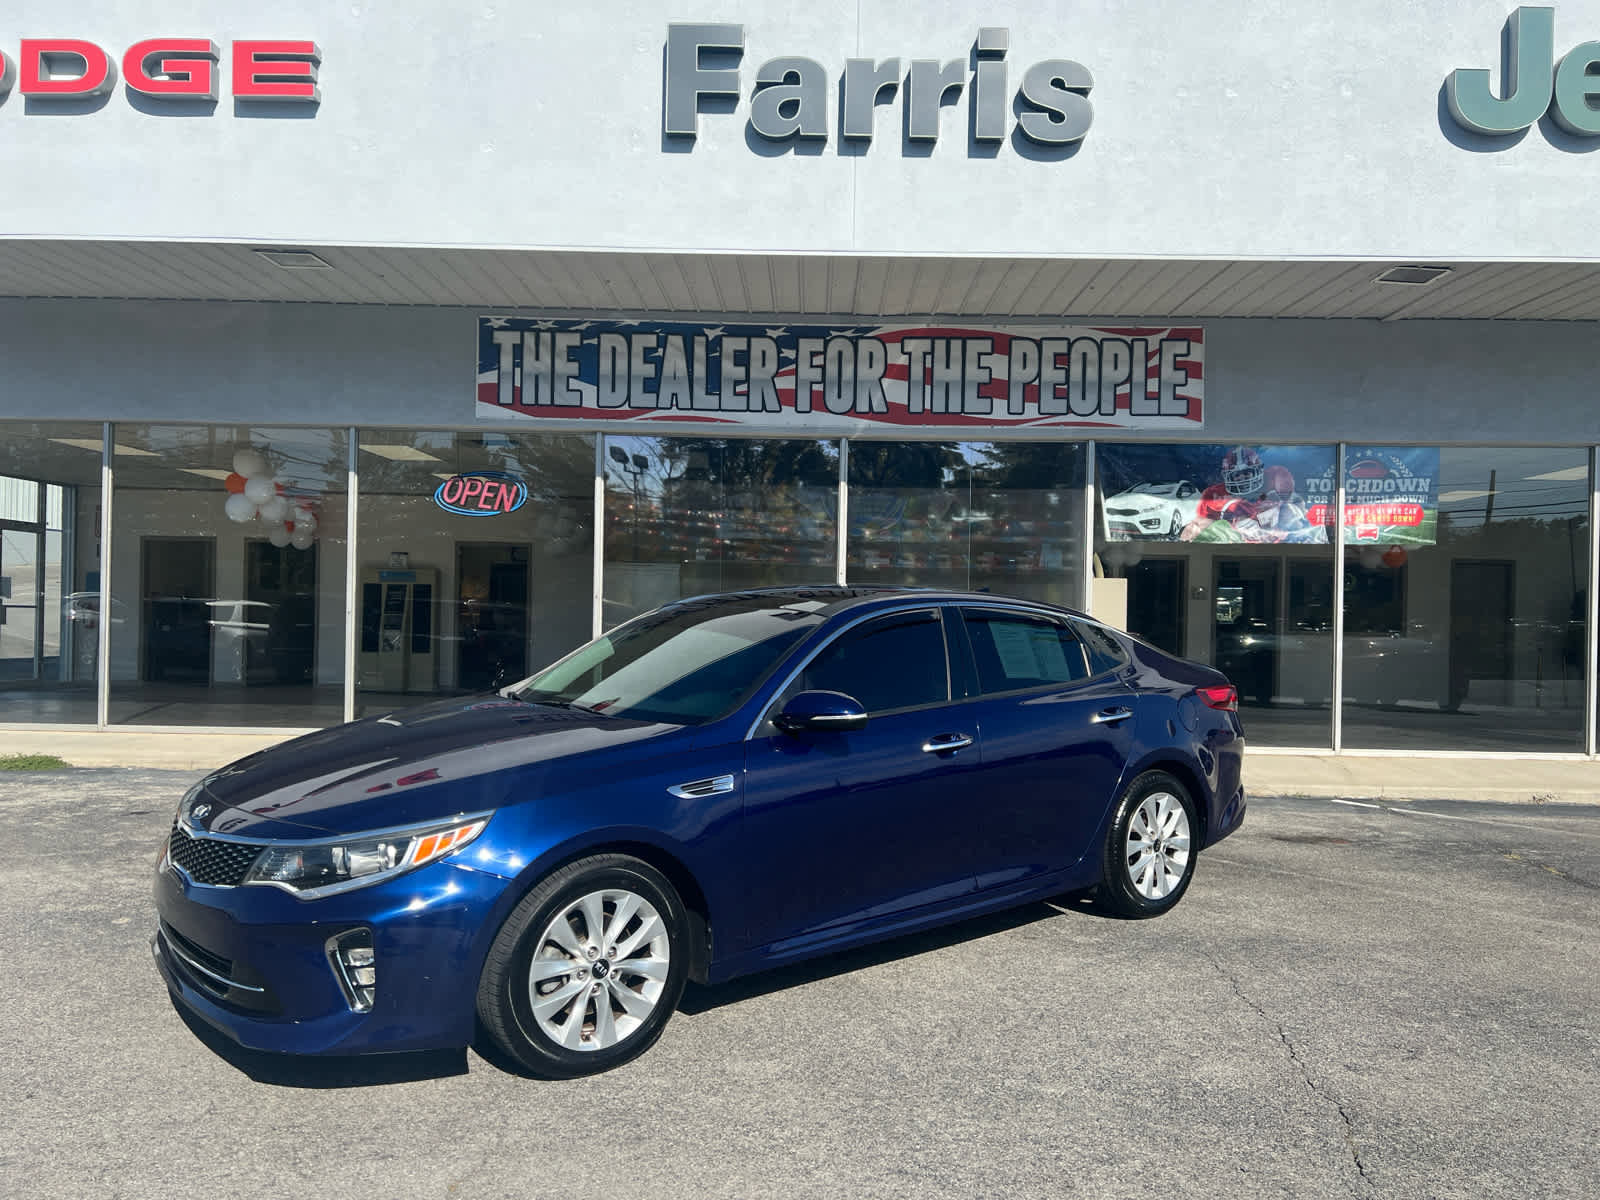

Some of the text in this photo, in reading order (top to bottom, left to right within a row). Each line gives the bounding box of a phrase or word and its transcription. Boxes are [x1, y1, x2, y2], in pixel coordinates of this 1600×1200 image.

[0, 38, 320, 102] DGE
[664, 23, 1095, 145] Farris
[492, 331, 1192, 416] THE DEALER FOR THE PEOPLE
[442, 476, 518, 513] OPEN
[1306, 478, 1432, 493] TOCHDOWN
[1306, 495, 1329, 504] FOR
